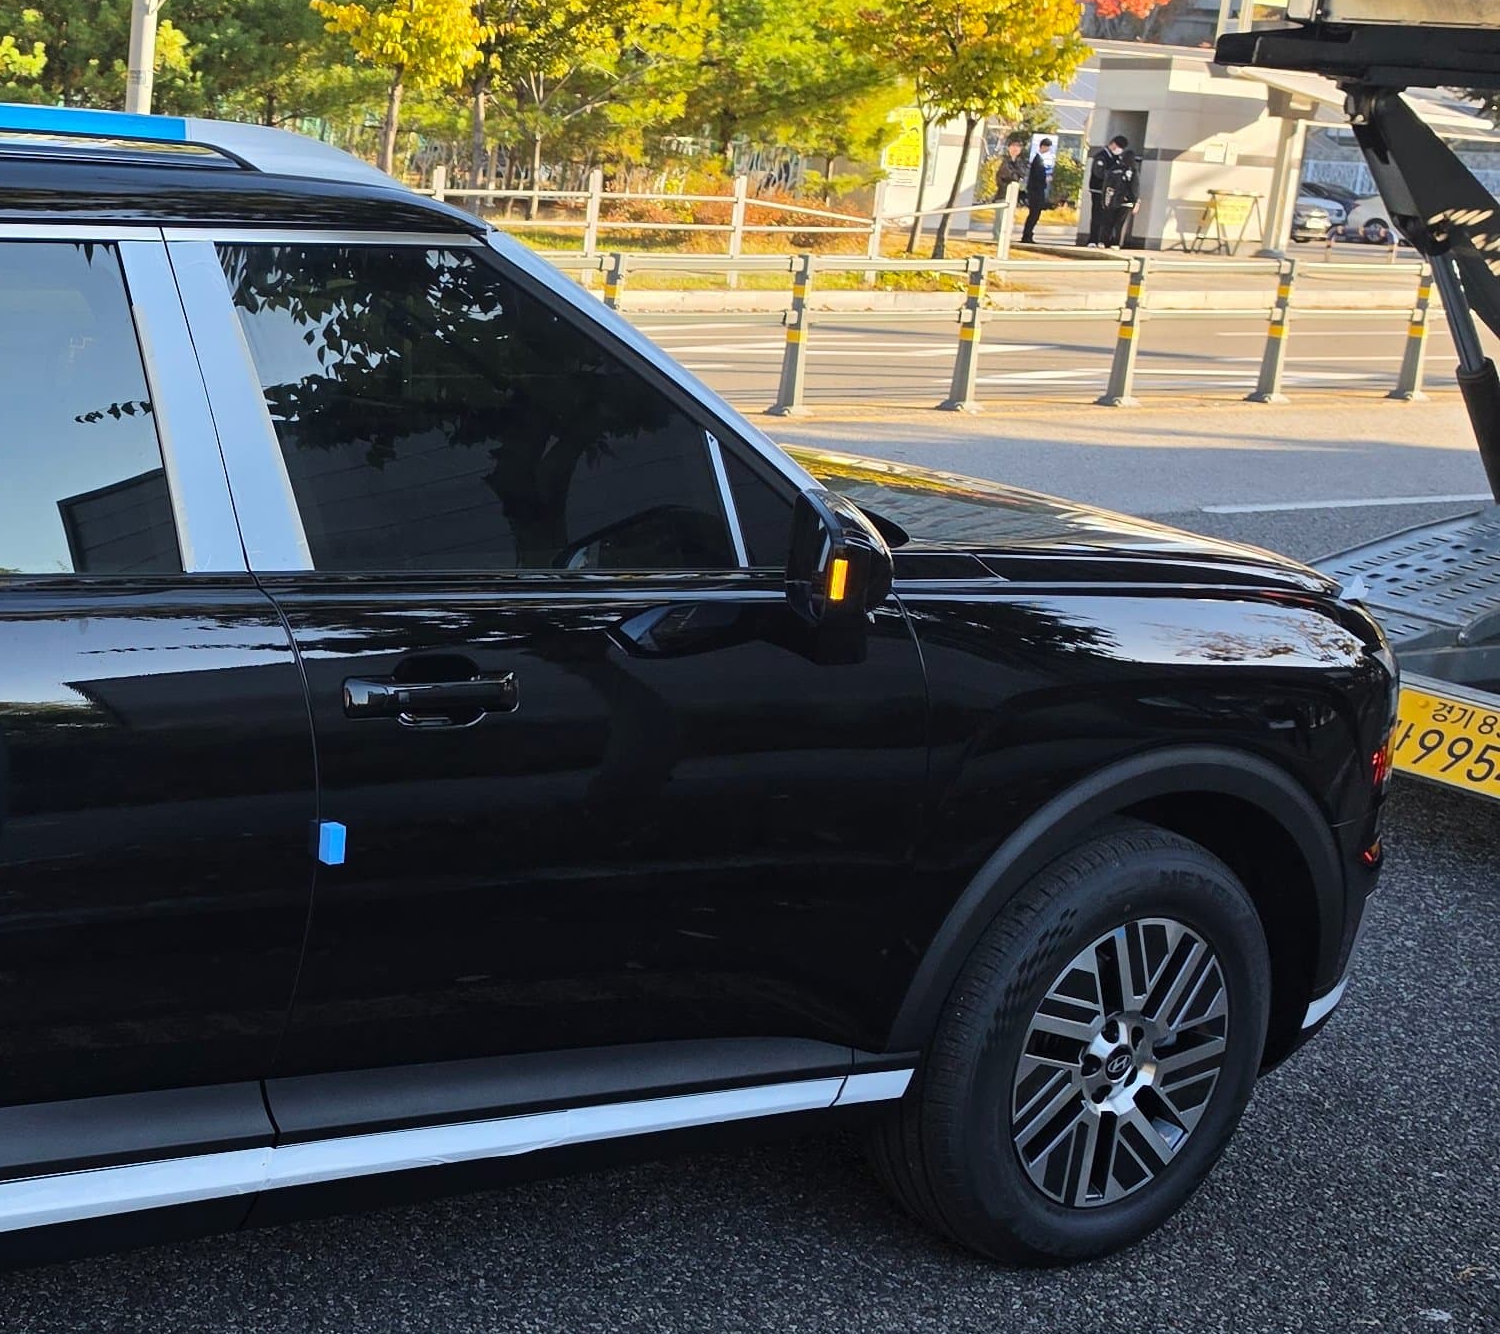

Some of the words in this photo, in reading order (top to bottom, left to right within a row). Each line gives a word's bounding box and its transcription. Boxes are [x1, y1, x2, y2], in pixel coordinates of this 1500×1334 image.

[1431, 702, 1476, 730] 경기
[1477, 715, 1500, 739] 8
[1394, 720, 1500, 782] 995
